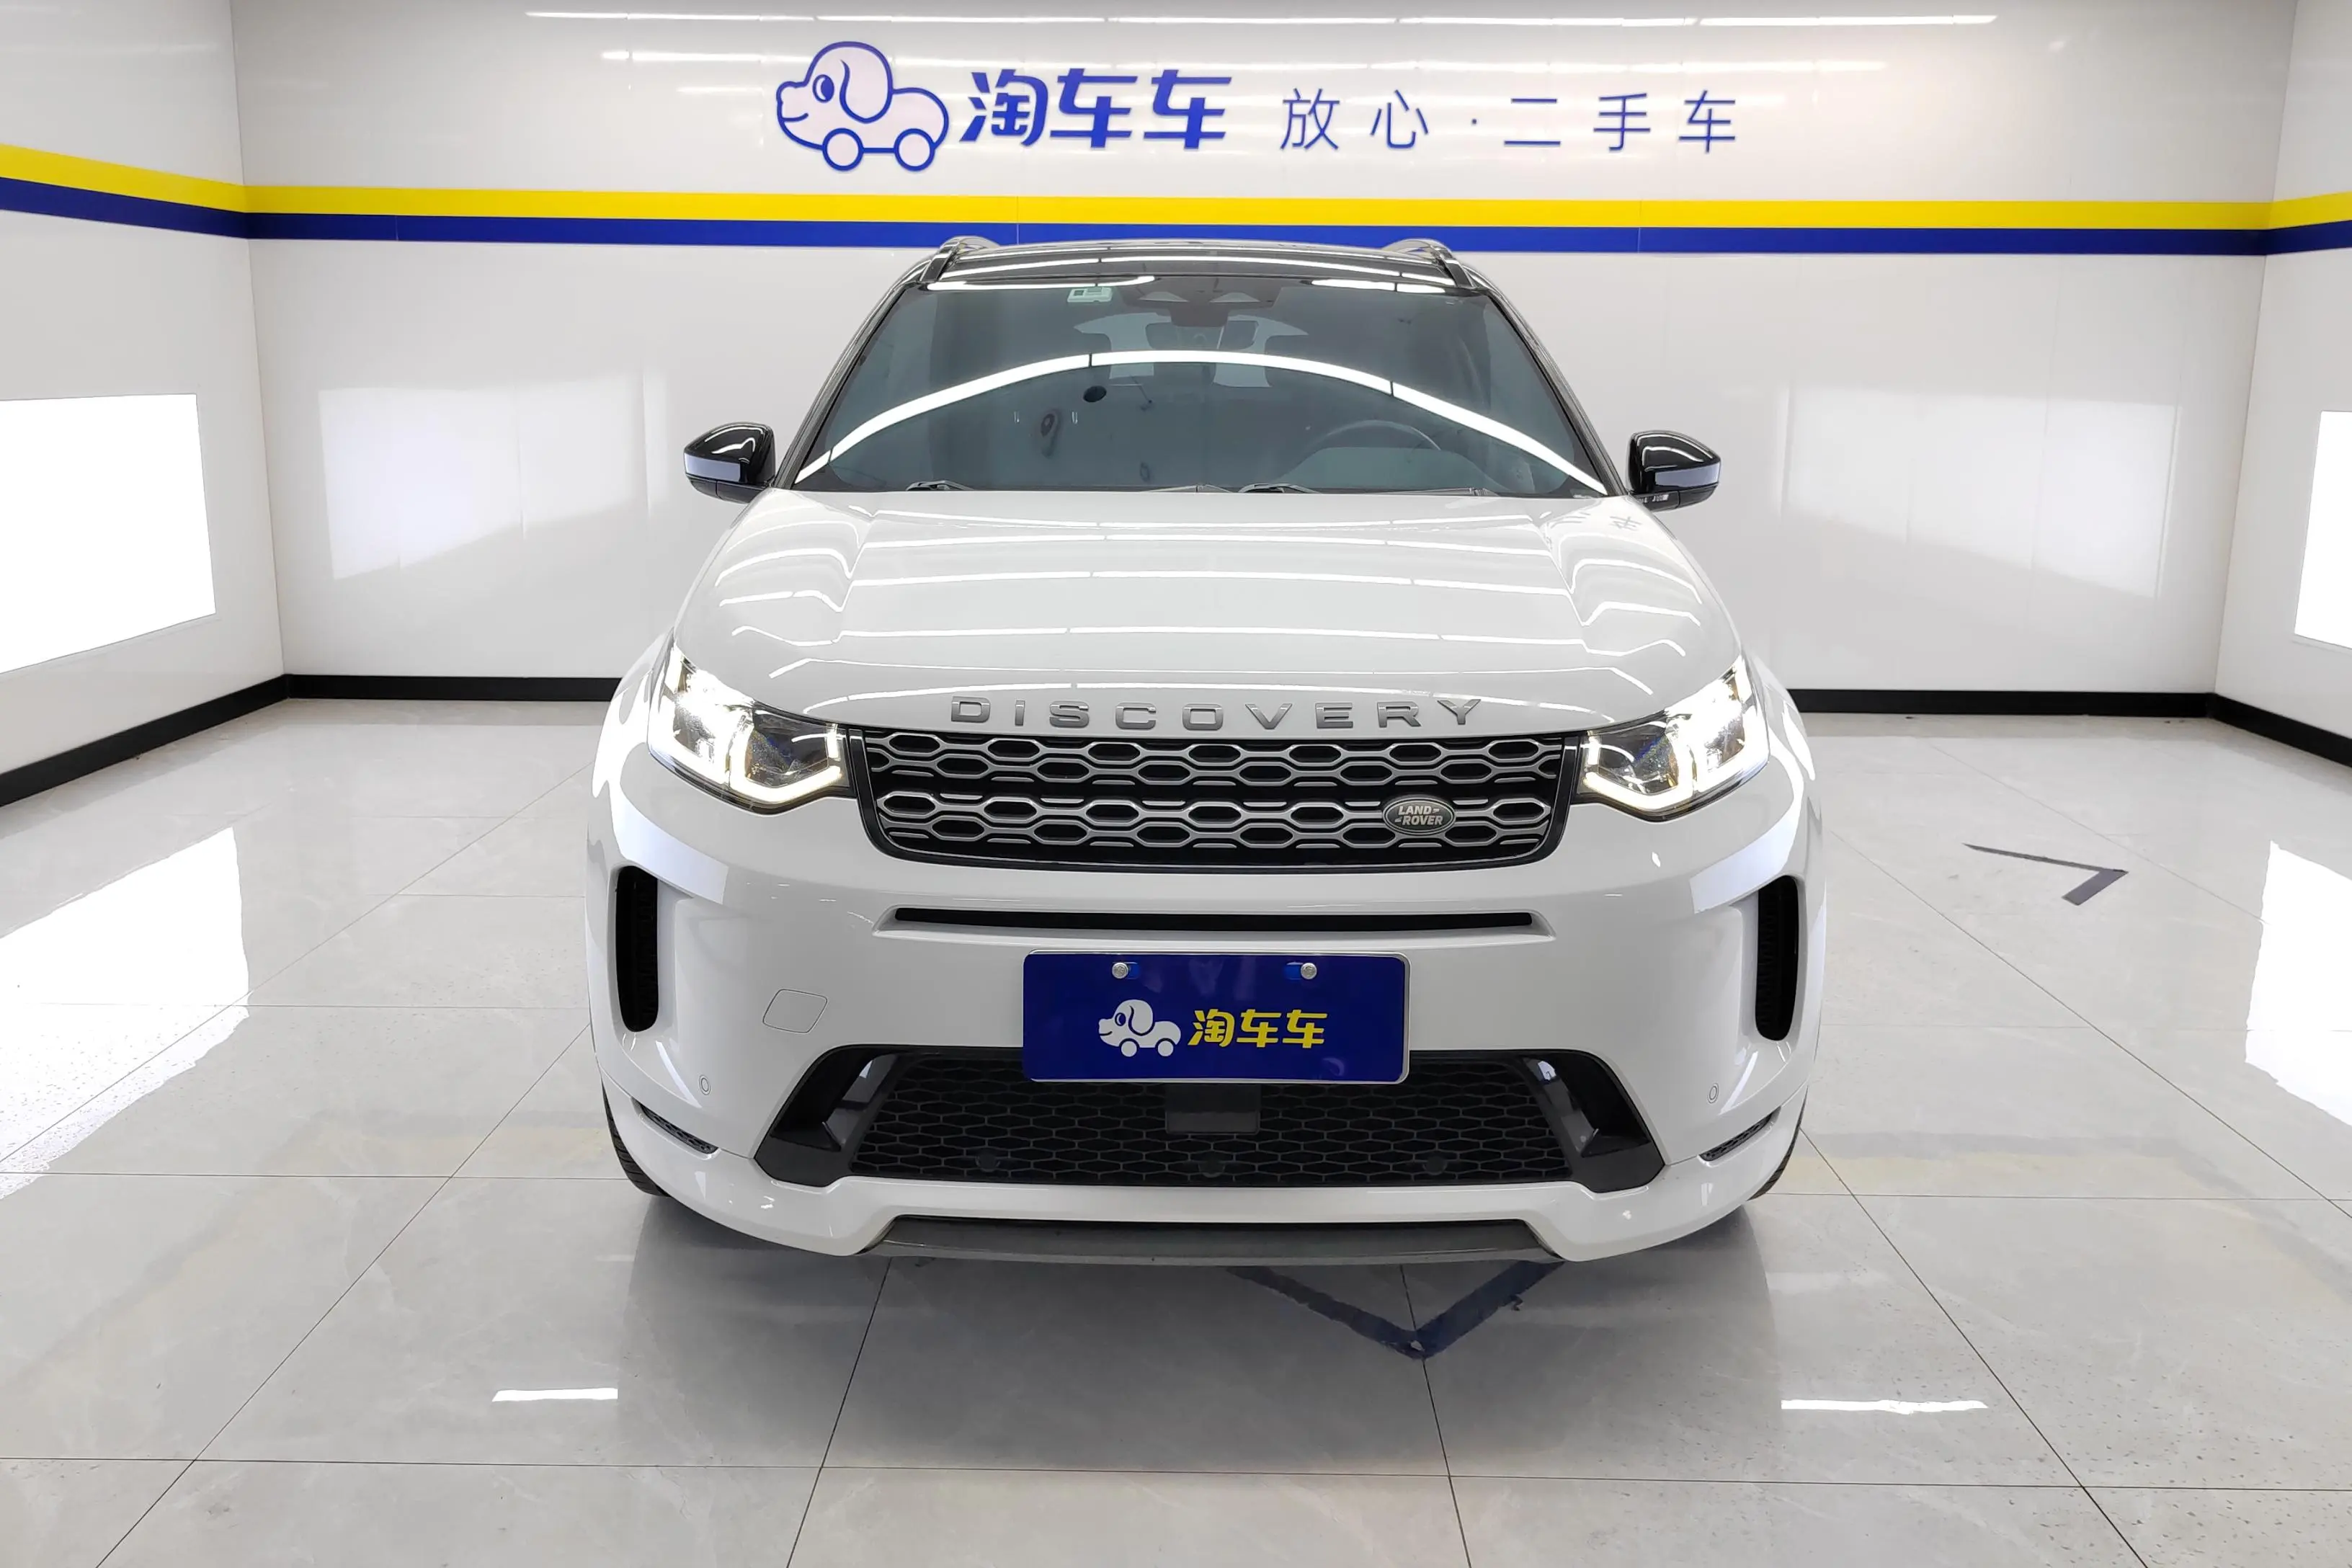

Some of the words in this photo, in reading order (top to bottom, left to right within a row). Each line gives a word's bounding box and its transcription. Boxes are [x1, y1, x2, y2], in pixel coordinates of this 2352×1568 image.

[959, 68, 1231, 149] 淘车车
[950, 695, 1482, 731] DISCOVERY
[1399, 806, 1432, 815] LAND
[1402, 815, 1443, 825] ROVER
[1188, 1009, 1329, 1048] 淘车车
